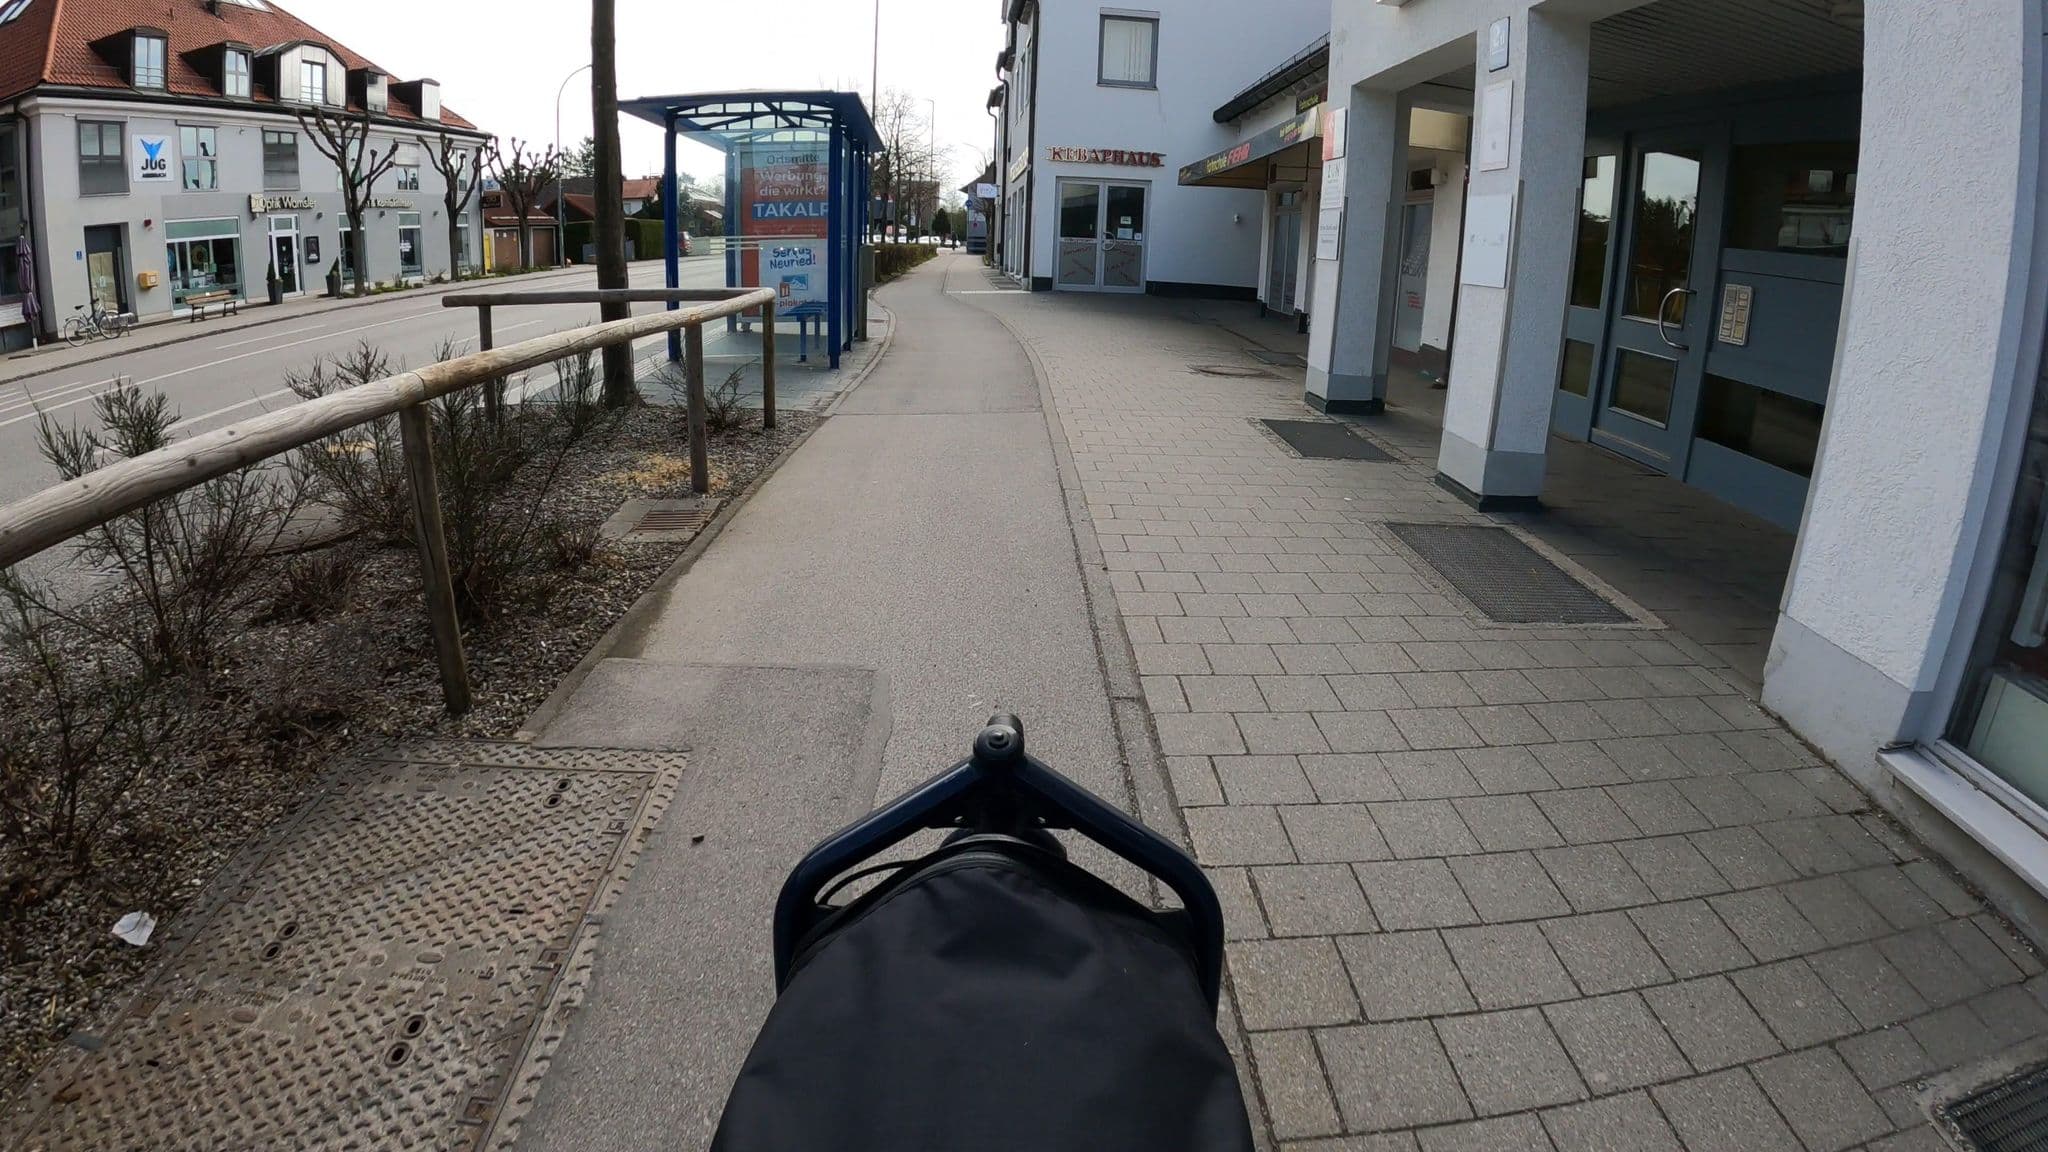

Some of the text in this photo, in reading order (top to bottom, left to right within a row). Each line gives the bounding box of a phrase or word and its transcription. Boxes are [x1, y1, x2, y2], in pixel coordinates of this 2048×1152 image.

[141, 158, 166, 170] JUG
[1051, 147, 1161, 167] KEBAPHAUS
[759, 184, 780, 197] die
[769, 253, 817, 270] Neuried!
